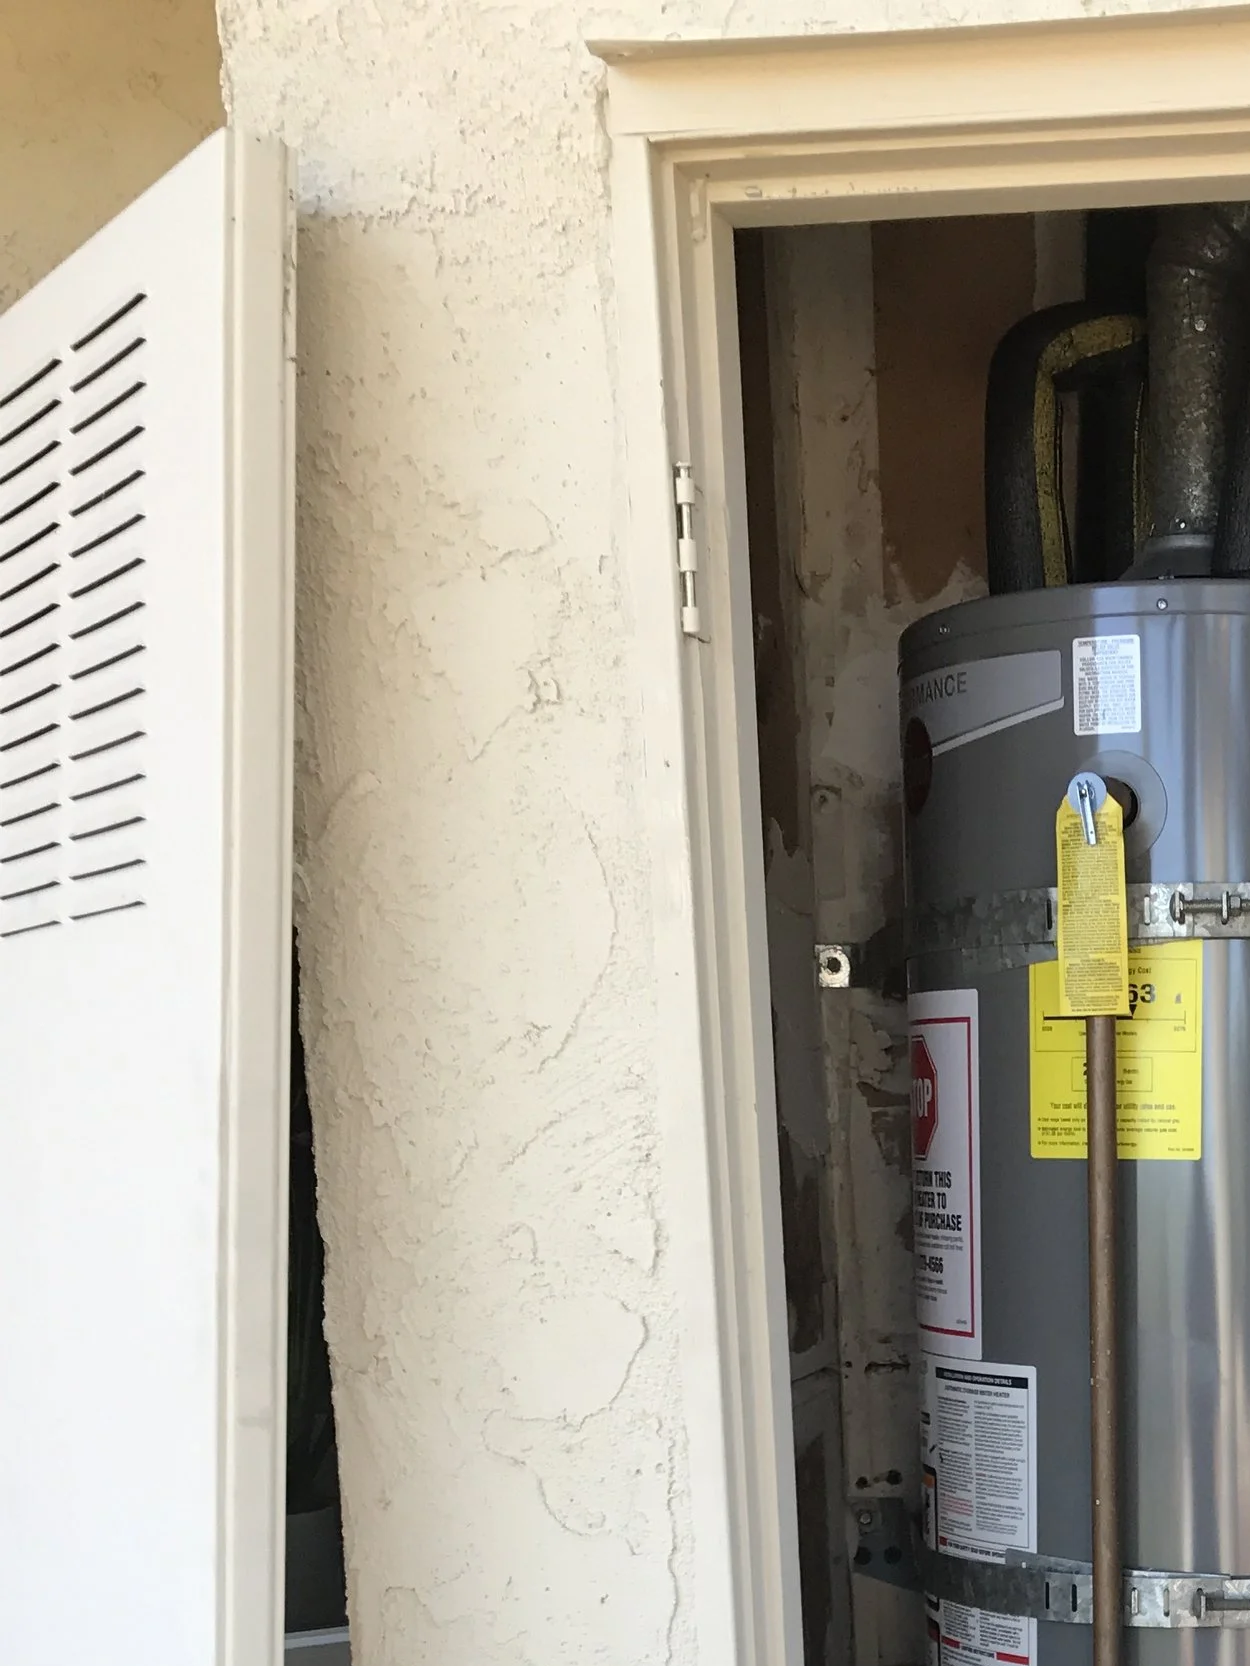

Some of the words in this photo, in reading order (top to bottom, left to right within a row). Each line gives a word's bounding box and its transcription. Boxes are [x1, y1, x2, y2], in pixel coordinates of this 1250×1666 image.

[934, 1171, 952, 1189] THIS
[937, 1192, 947, 1210] TO
[924, 1213, 963, 1232] PURCHASE
